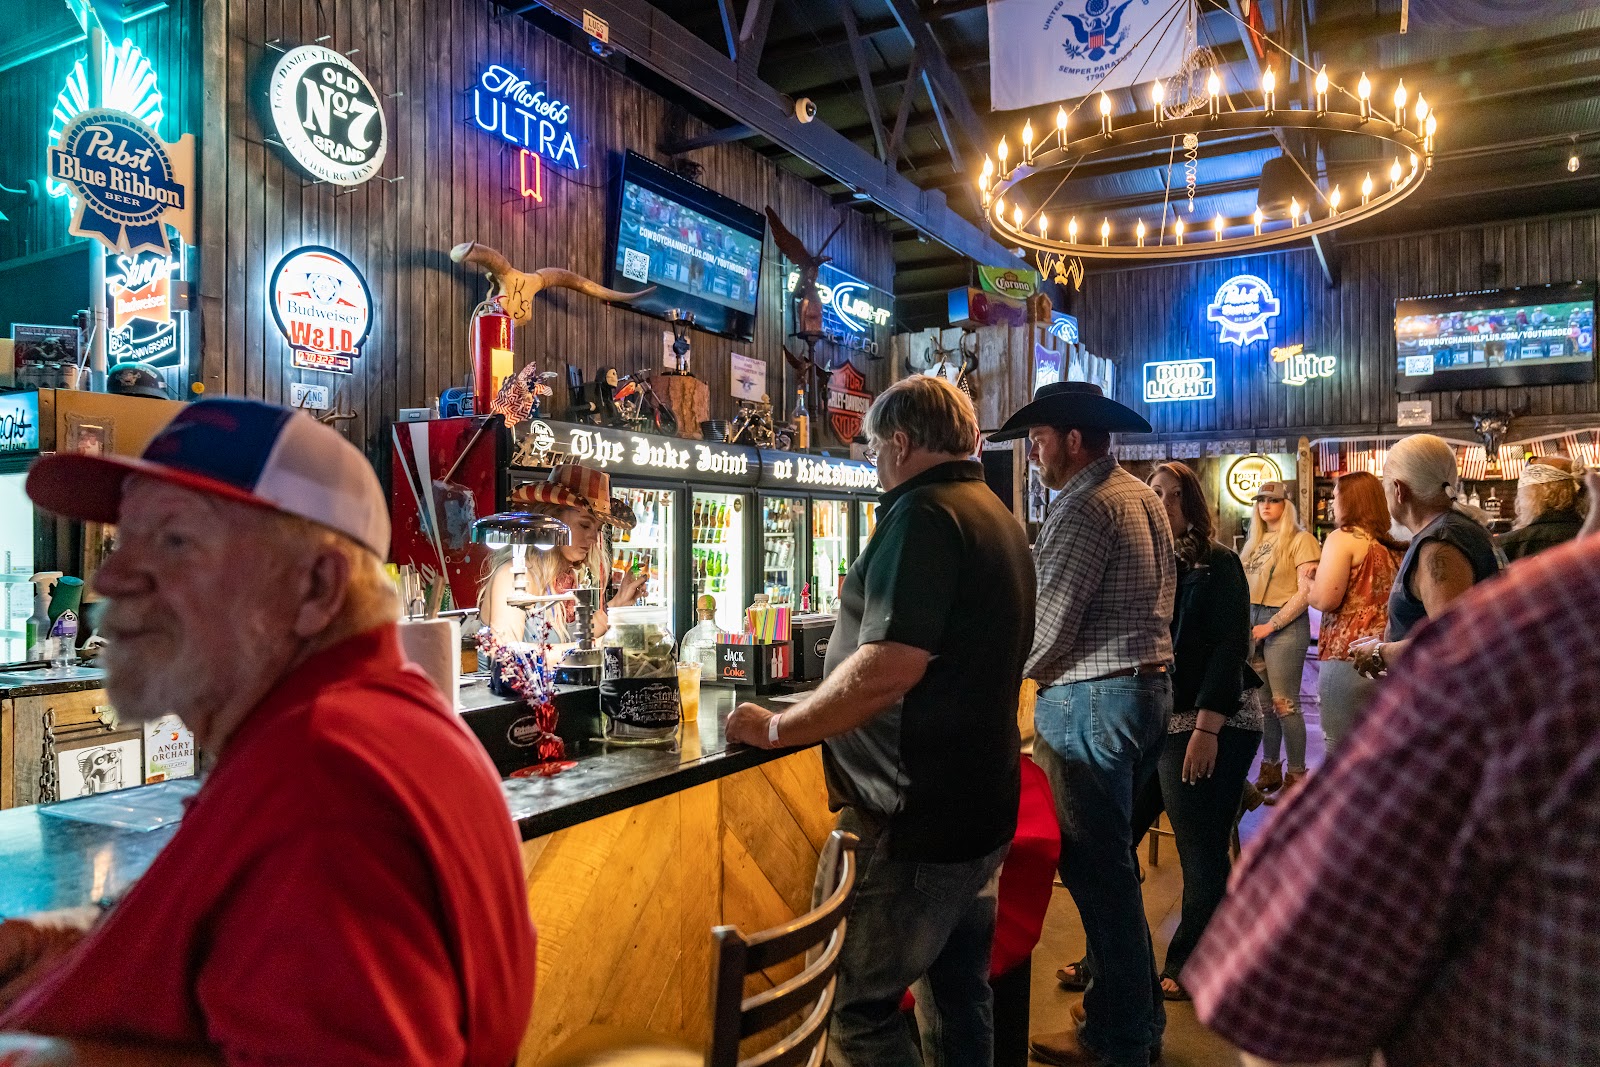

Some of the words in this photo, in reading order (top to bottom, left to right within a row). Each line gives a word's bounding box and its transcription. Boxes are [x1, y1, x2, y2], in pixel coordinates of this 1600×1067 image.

[1043, 0, 1064, 31] UNITED
[1058, 64, 1091, 75] SEMPER
[1093, 52, 1132, 73] PARATUS
[322, 67, 359, 94] OLD
[1086, 72, 1105, 82] 1790
[482, 65, 570, 124] Michelob
[475, 89, 579, 169] ULTRA
[85, 125, 154, 172] Pabst
[313, 134, 366, 163] BRAND
[57, 152, 107, 187] Blue
[109, 166, 181, 208] Ribbon
[105, 191, 141, 207] BEER
[995, 277, 1030, 292] Corona
[118, 292, 167, 314] Budweiser
[788, 272, 832, 304] BD
[842, 293, 890, 326] LIGHT
[287, 299, 359, 325] Budweiser
[862, 338, 879, 355] GO
[1418, 328, 1573, 346] COWBOYCHANNELPLUS.COM/YOUTHRODEO
[1156, 362, 1204, 383] BUD
[1282, 353, 1337, 386] Lite
[1147, 377, 1213, 399] LIGHT
[569, 429, 625, 467] The
[631, 436, 691, 469] Juke
[694, 444, 748, 475] Joint
[773, 458, 793, 479] at
[1239, 480, 1262, 490] CAB
[724, 648, 745, 661] JACK
[723, 666, 745, 677] Coke
[152, 748, 194, 762] ORCHARD
[157, 741, 191, 754] ANGRY
